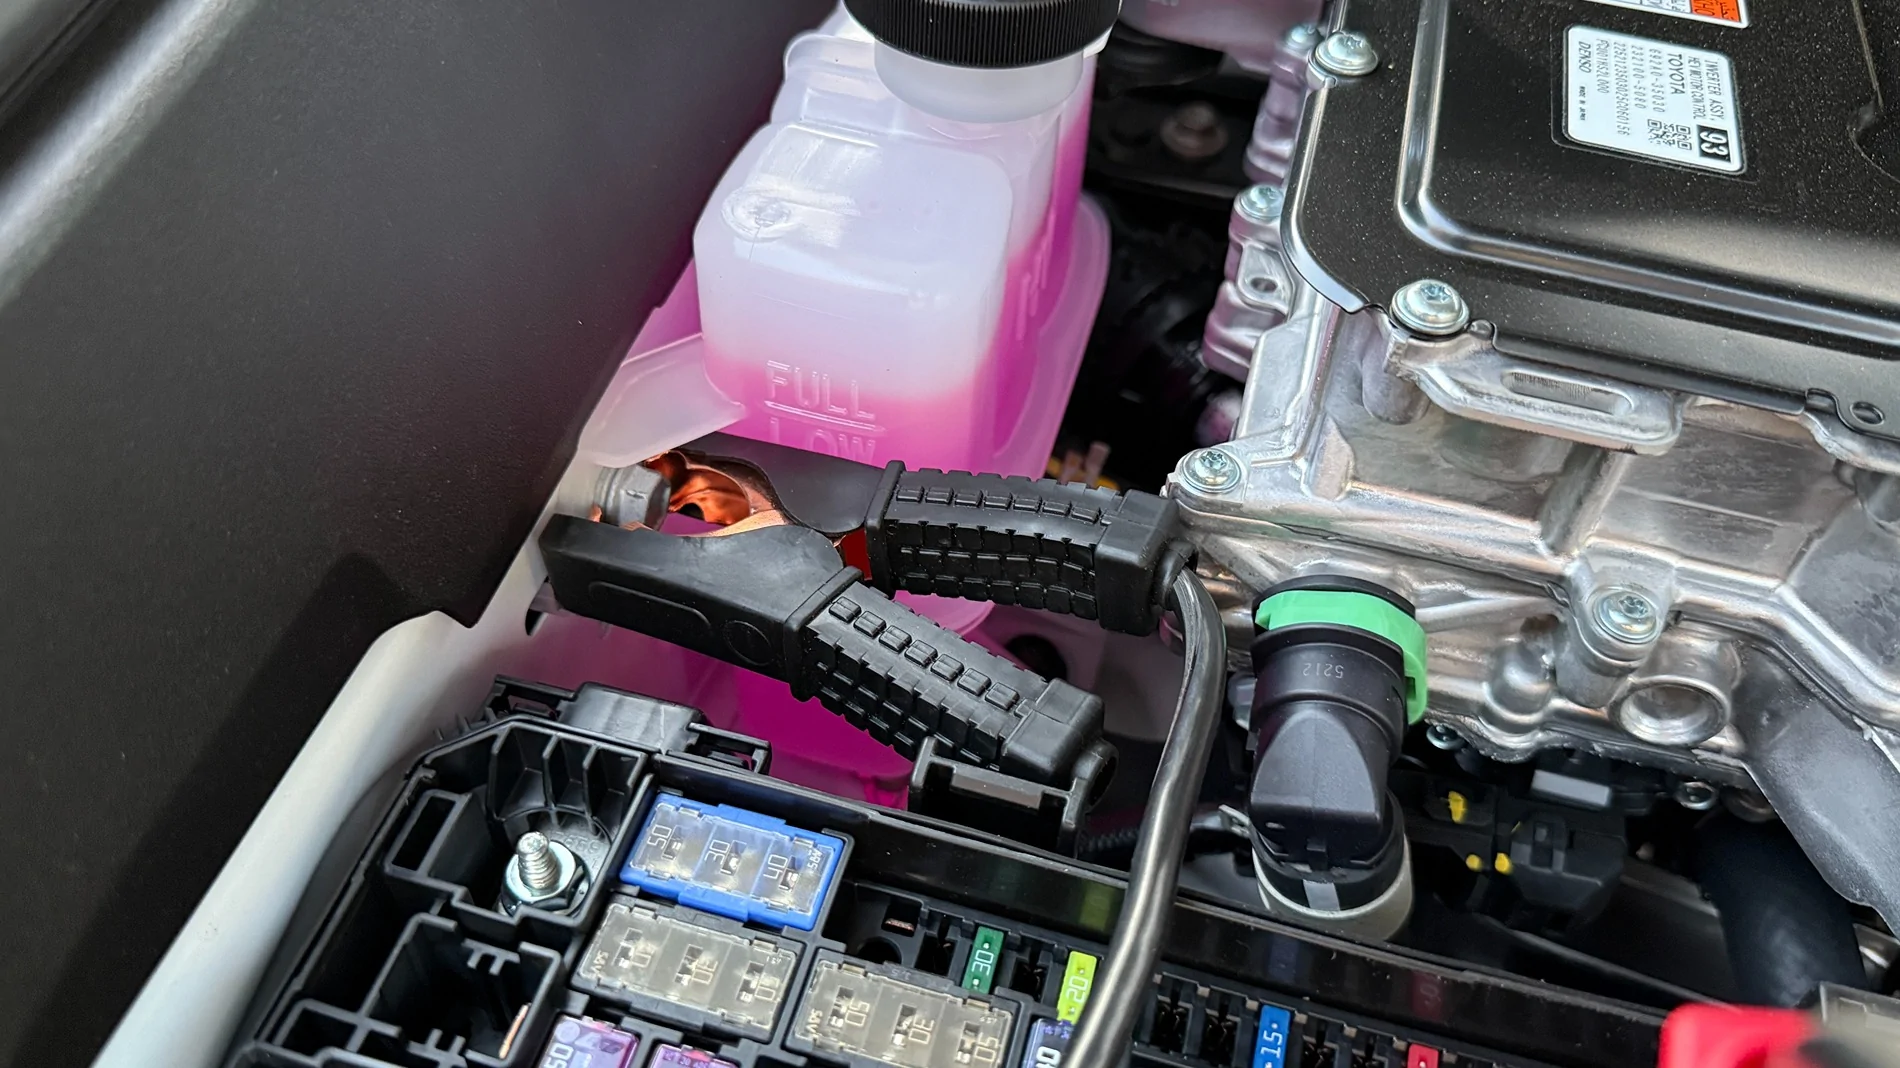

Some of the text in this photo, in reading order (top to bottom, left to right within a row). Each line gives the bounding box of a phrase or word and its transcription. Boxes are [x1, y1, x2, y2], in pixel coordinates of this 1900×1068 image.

[1578, 41, 1592, 73] DENSO
[1667, 53, 1686, 94] TOYOTA
[1689, 69, 1704, 91] MOTOR
[1704, 60, 1722, 96] INVERTER
[1691, 91, 1707, 120] CONTROL
[1699, 131, 1728, 155] 93
[765, 360, 876, 418] FULL
[1302, 662, 1344, 679] 5212
[647, 824, 672, 850] 50
[704, 840, 730, 865] 30
[764, 854, 788, 880] 40
[691, 958, 718, 985] 30
[972, 949, 994, 976] 30
[1066, 976, 1089, 1003] 20
[844, 998, 870, 1027] 50
[908, 1014, 934, 1044] 30
[973, 1032, 999, 1063] 50
[1260, 1030, 1283, 1060] 15
